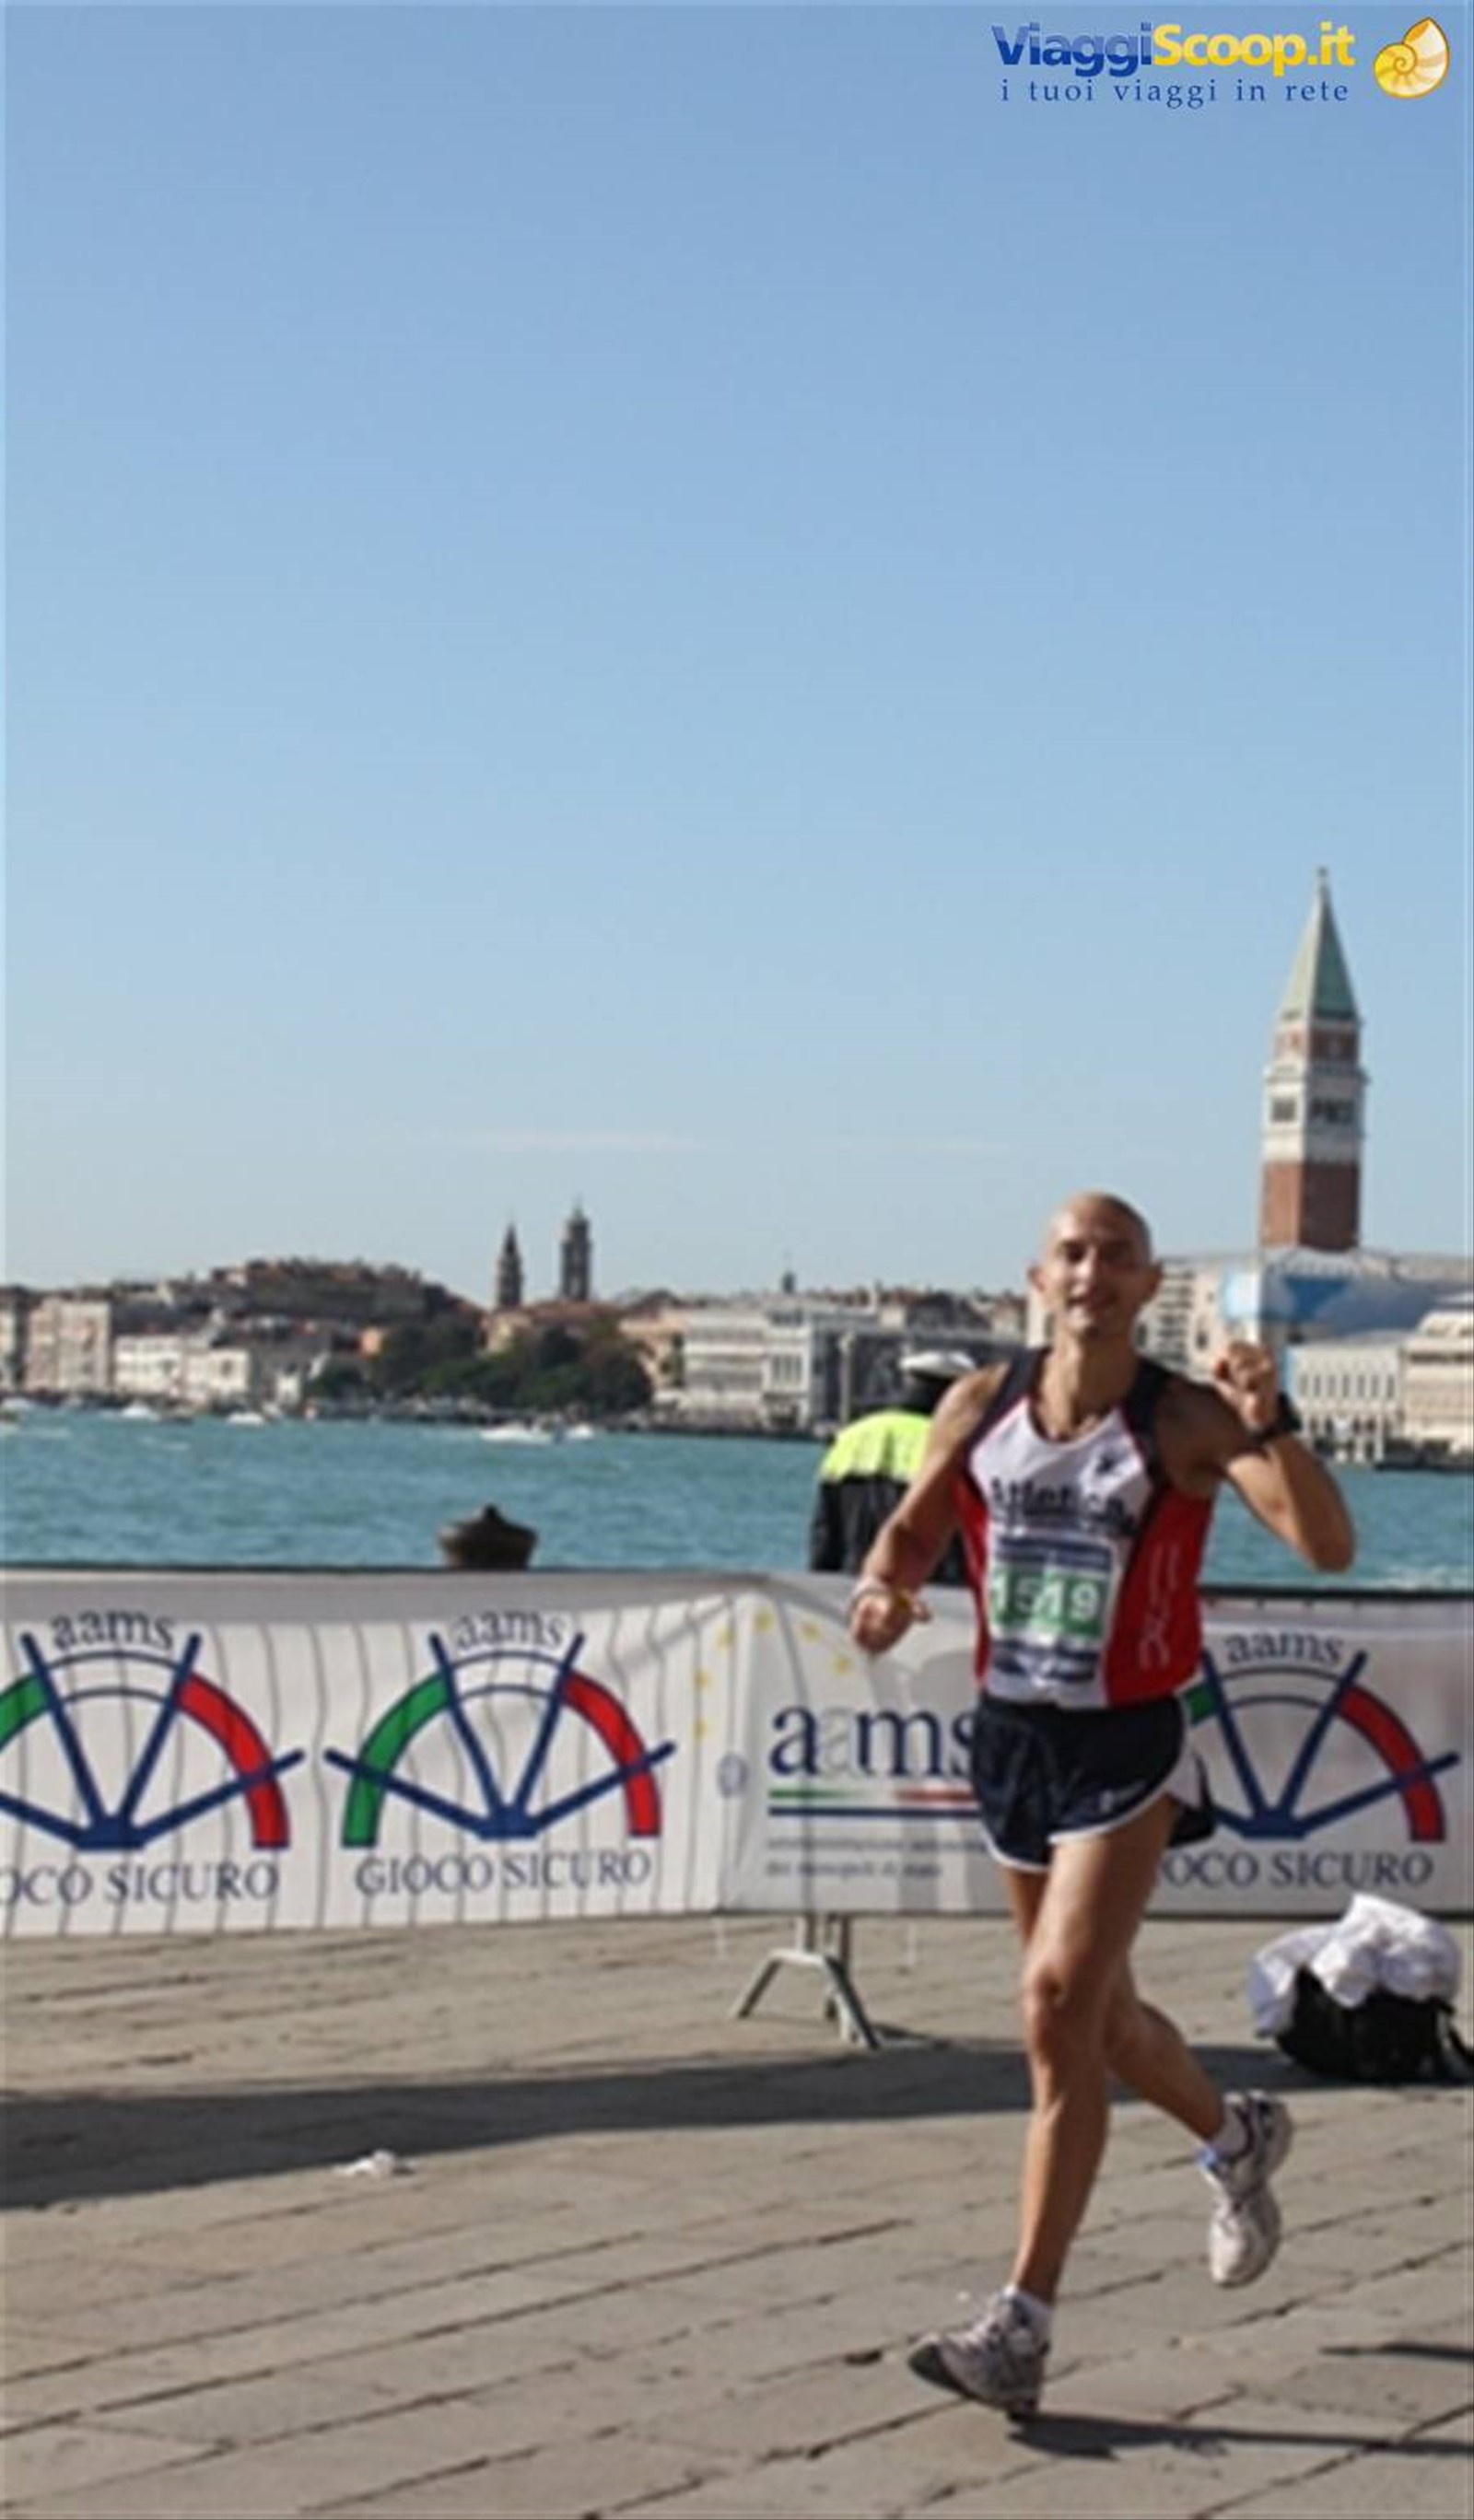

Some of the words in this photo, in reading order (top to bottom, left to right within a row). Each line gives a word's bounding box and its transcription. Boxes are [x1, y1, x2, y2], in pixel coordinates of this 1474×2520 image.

[51, 1610, 175, 1651] aams
[453, 1610, 565, 1650] aams
[1224, 1632, 1344, 1663] aams
[105, 1861, 280, 1902] SICURO
[355, 1852, 492, 1896] GIOCO
[502, 1849, 651, 1889] SICURO
[1269, 1849, 1434, 1887] SICURO
